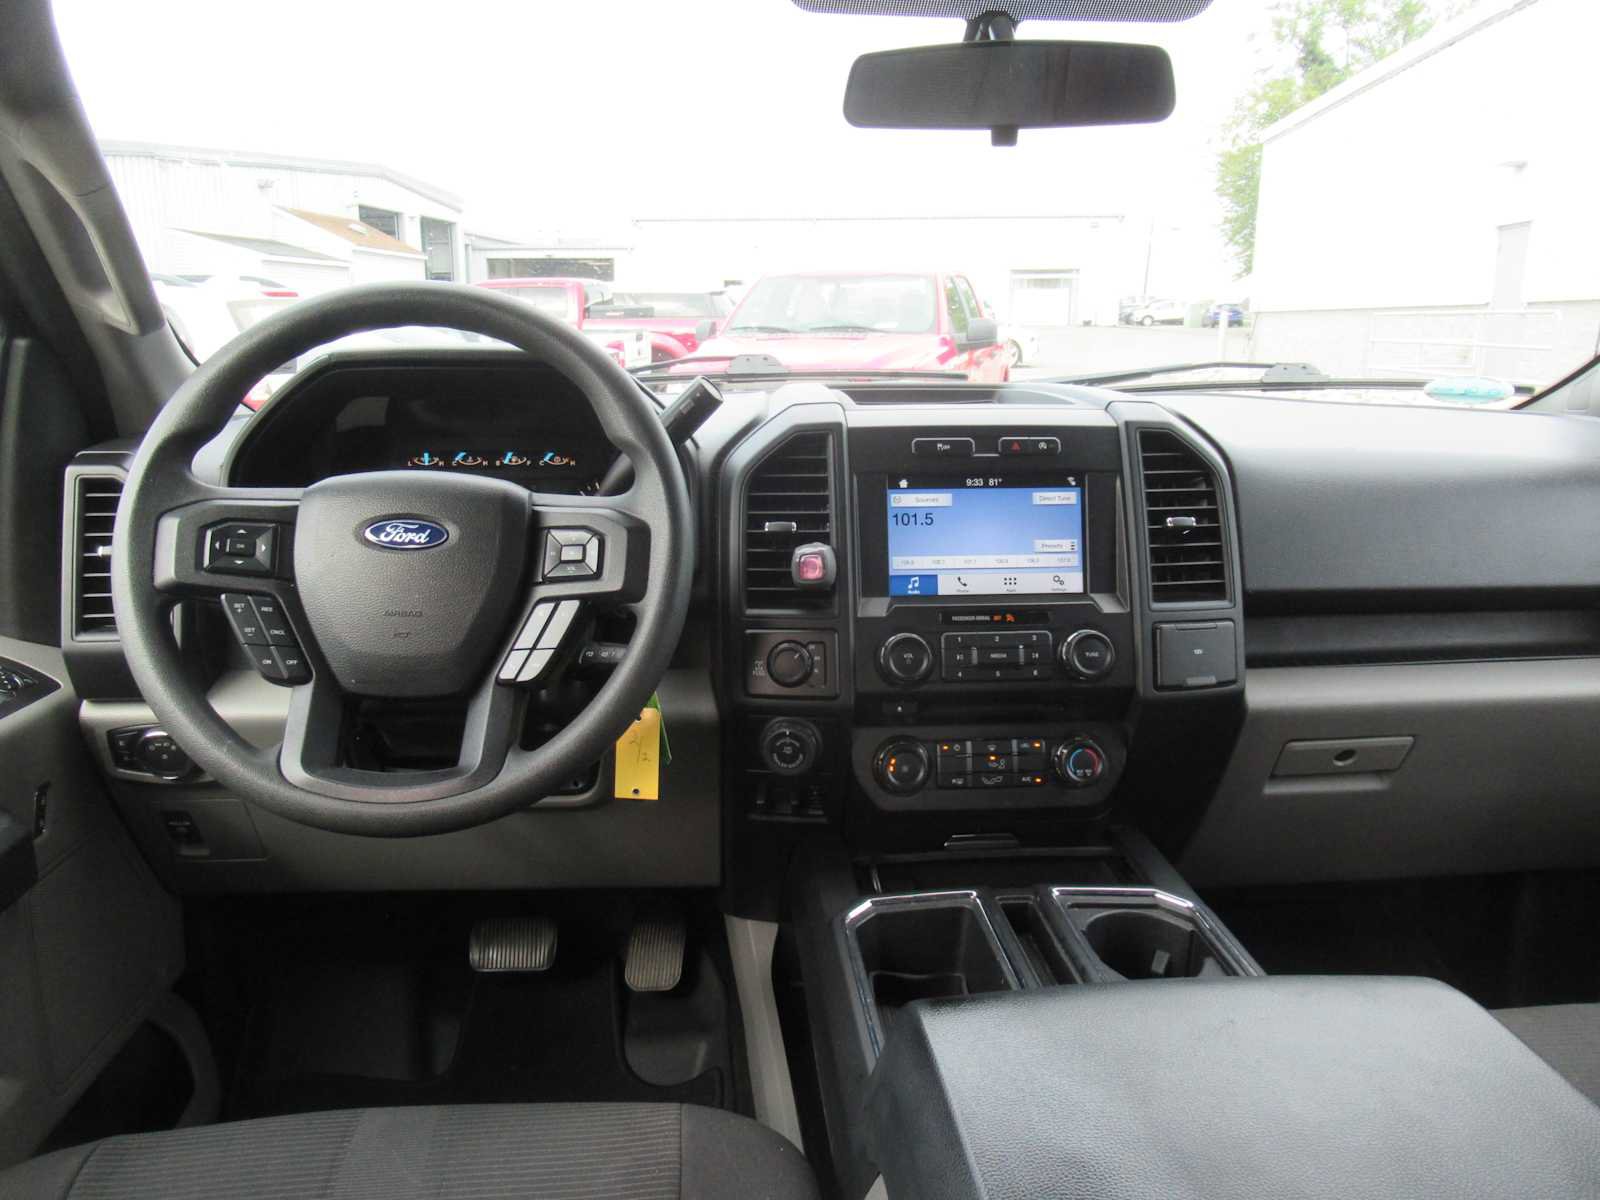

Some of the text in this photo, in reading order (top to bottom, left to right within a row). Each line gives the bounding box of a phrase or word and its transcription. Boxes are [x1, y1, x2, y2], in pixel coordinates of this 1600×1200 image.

[966, 478, 984, 487] 9:33
[892, 512, 935, 526] 101.5
[380, 522, 432, 544] Ford
